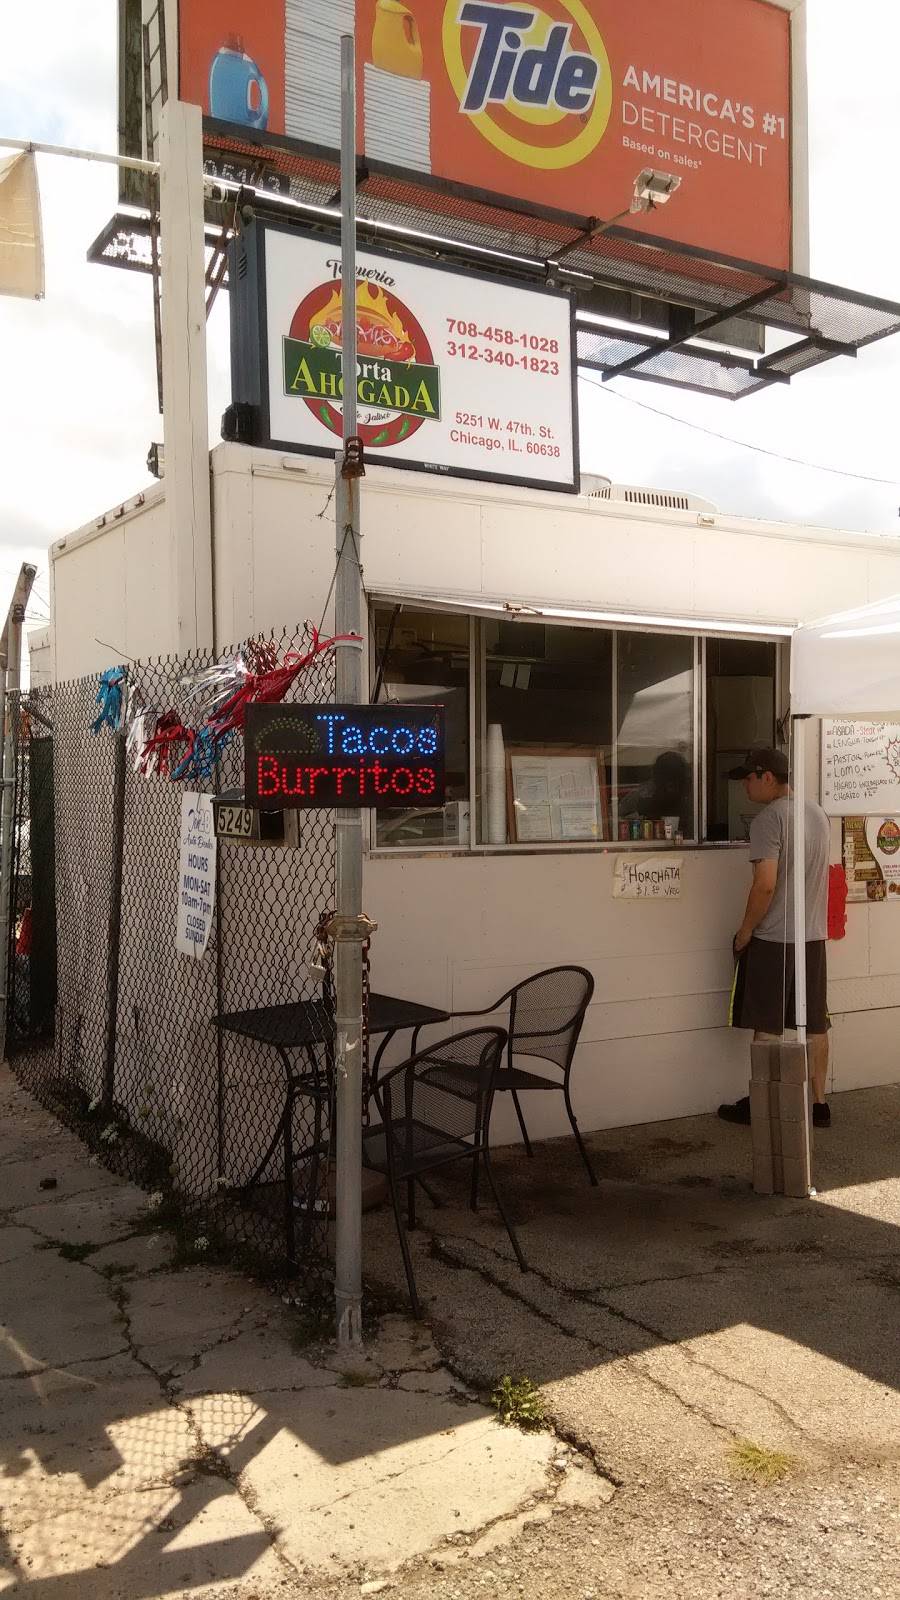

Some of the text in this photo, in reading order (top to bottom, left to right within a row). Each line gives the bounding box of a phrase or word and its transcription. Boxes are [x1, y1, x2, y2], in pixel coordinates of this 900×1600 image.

[458, 2, 598, 113] Tide
[622, 66, 786, 140] AMERICA'S #1
[622, 101, 767, 167] DETERGENT
[622, 136, 654, 156] Based
[657, 148, 671, 161] on
[326, 259, 395, 287] Tueria
[446, 318, 559, 354] 708-458-1028
[447, 341, 560, 376] 312-340-1823
[290, 357, 435, 413] AHGADA
[455, 412, 554, 439] 5251 W. 47th. St.
[450, 429, 560, 458] Chicago, IL. 60638
[316, 715, 438, 755] Tacos
[257, 755, 437, 797] Burritos
[219, 808, 252, 834] 5249
[188, 853, 208, 872] HOURS
[629, 863, 680, 884] HORCHATA
[183, 875, 211, 896] MON-SAT
[181, 890, 212, 916] 10am-7pm
[186, 914, 205, 932] CLOSED
